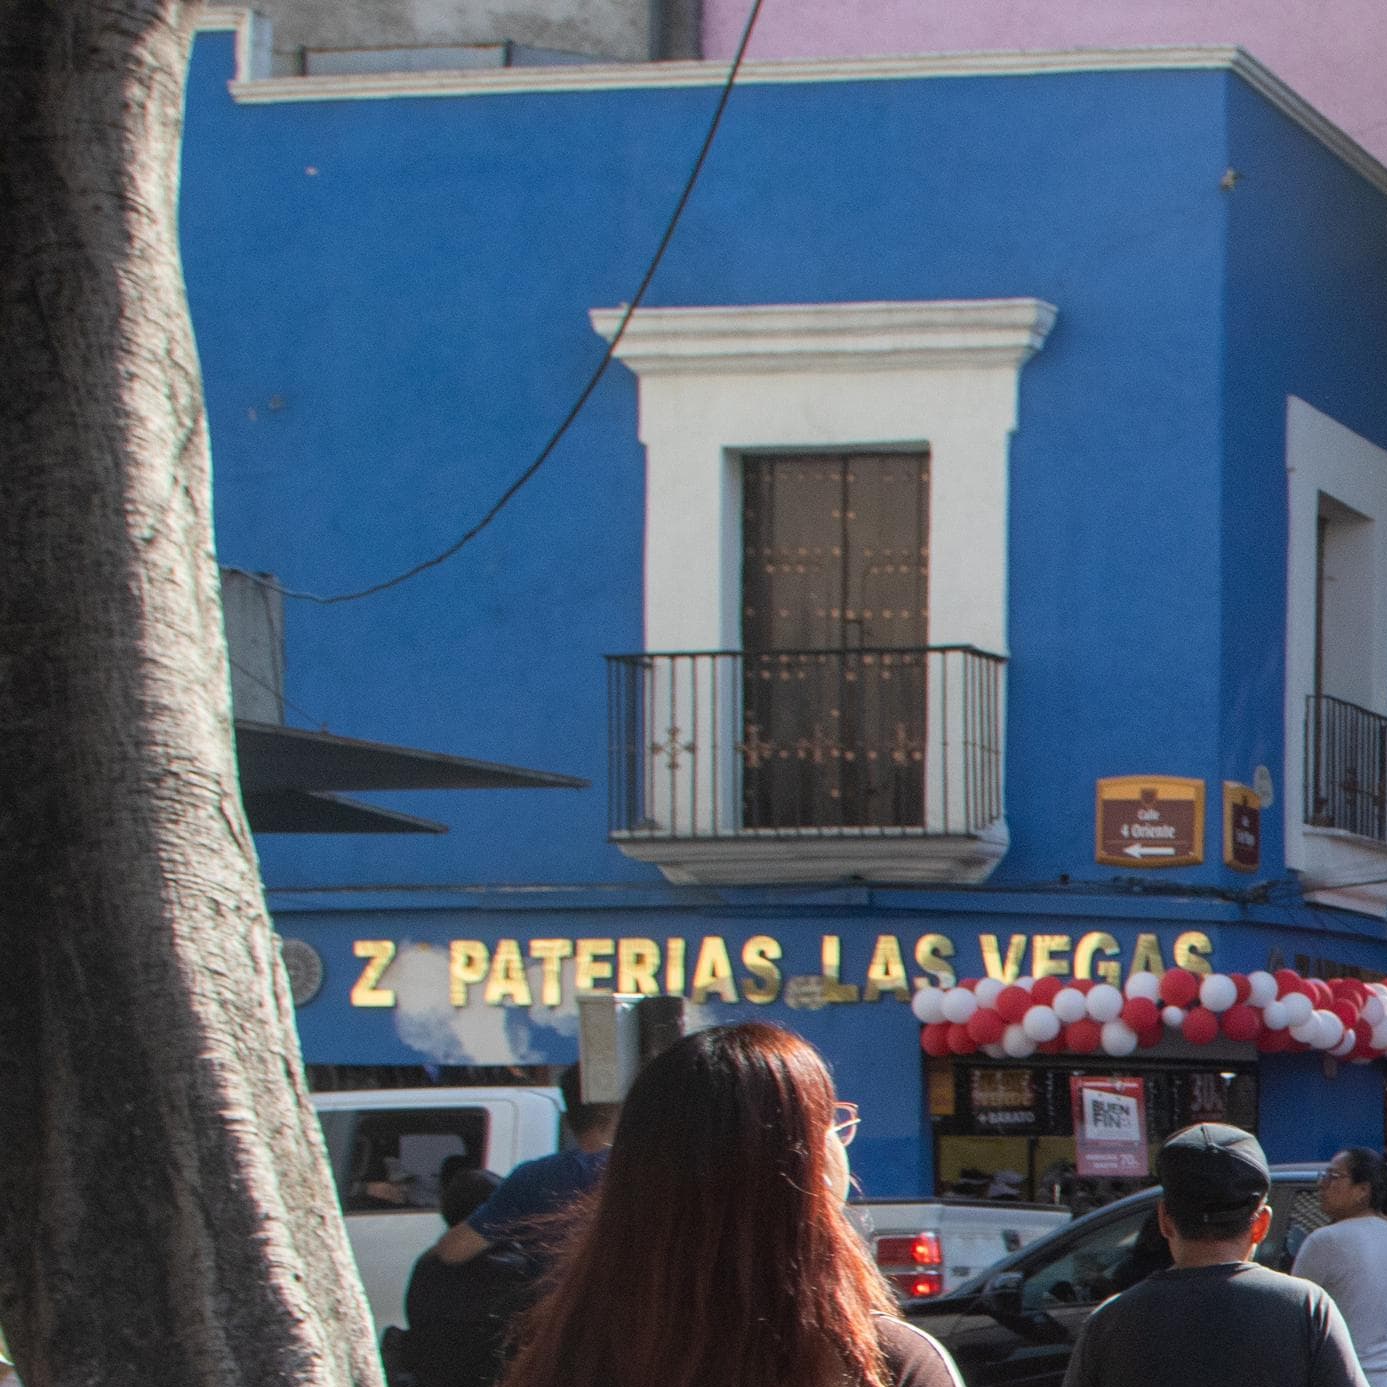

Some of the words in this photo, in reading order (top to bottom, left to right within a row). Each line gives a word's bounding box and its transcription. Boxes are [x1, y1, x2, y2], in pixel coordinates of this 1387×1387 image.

[1137, 809, 1160, 821] Calle
[1120, 824, 1129, 838] 4
[1131, 823, 1176, 839] Oriente
[818, 933, 956, 1003] LAS
[978, 930, 1215, 989] VEGAS
[1092, 1100, 1131, 1117] BUEN
